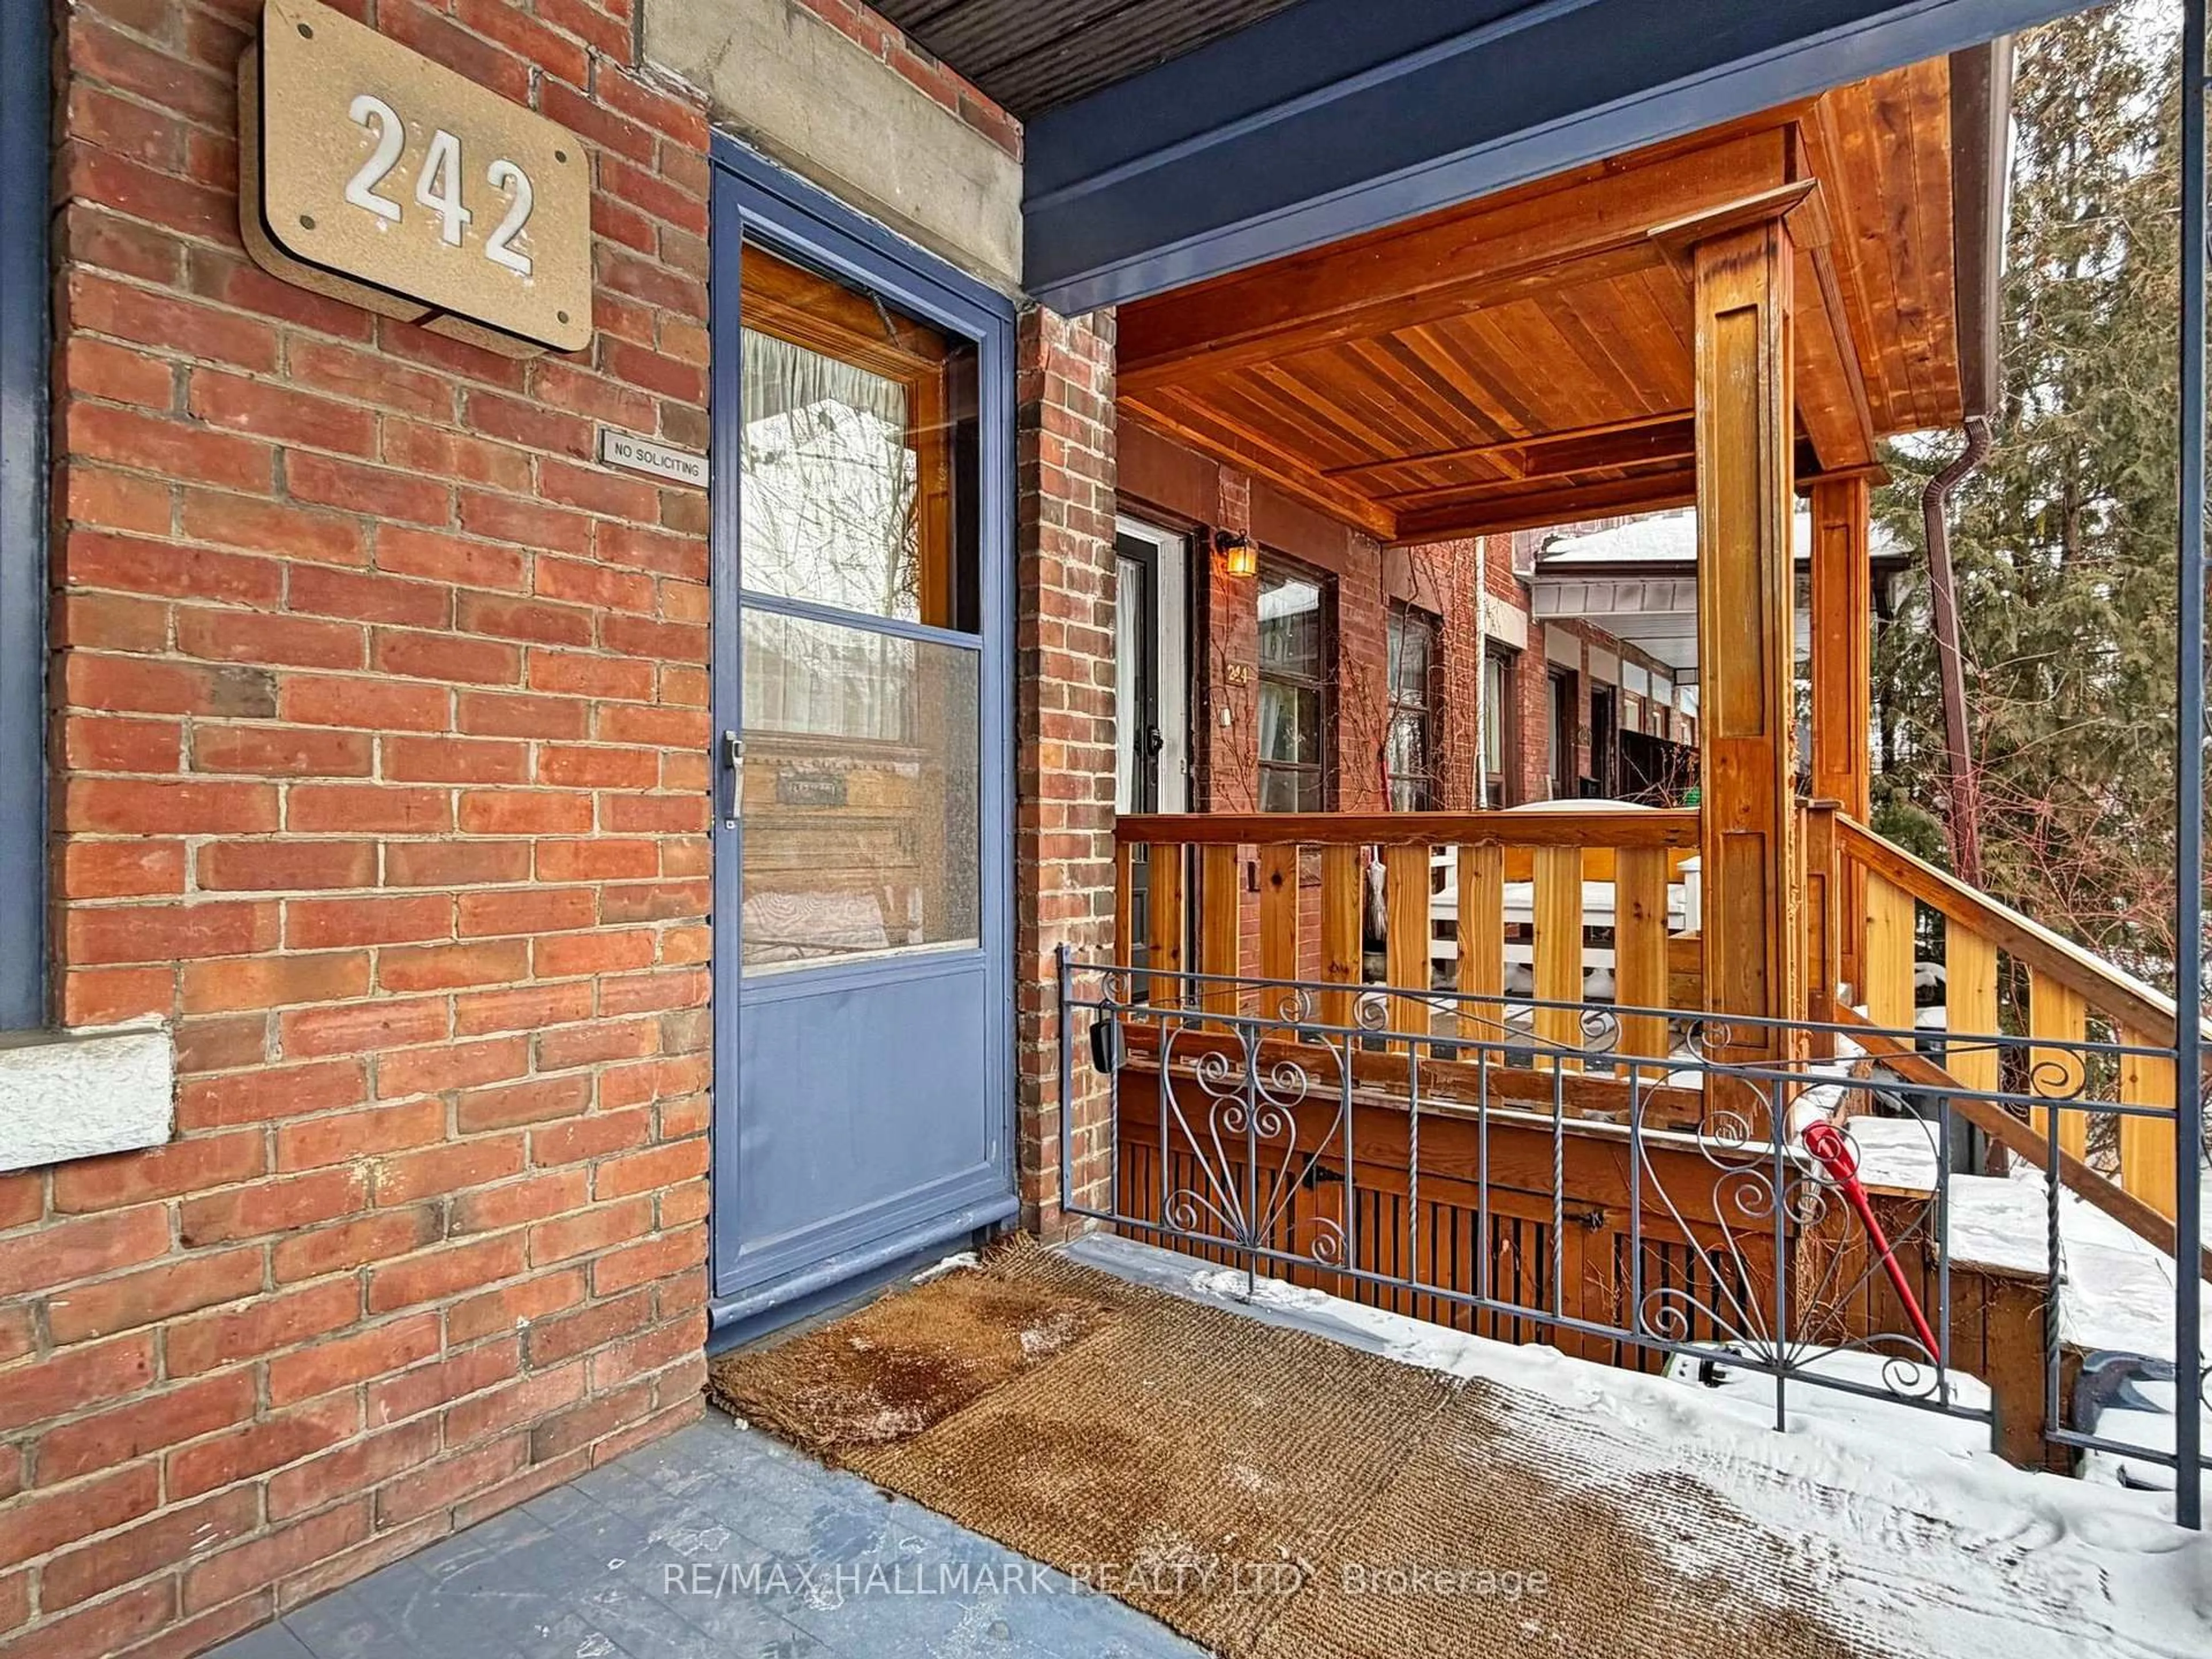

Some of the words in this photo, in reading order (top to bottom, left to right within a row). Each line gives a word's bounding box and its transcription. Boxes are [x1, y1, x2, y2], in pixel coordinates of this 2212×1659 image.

[345, 93, 534, 277] 242
[615, 442, 632, 458] NO
[636, 449, 699, 477] SOLICITING
